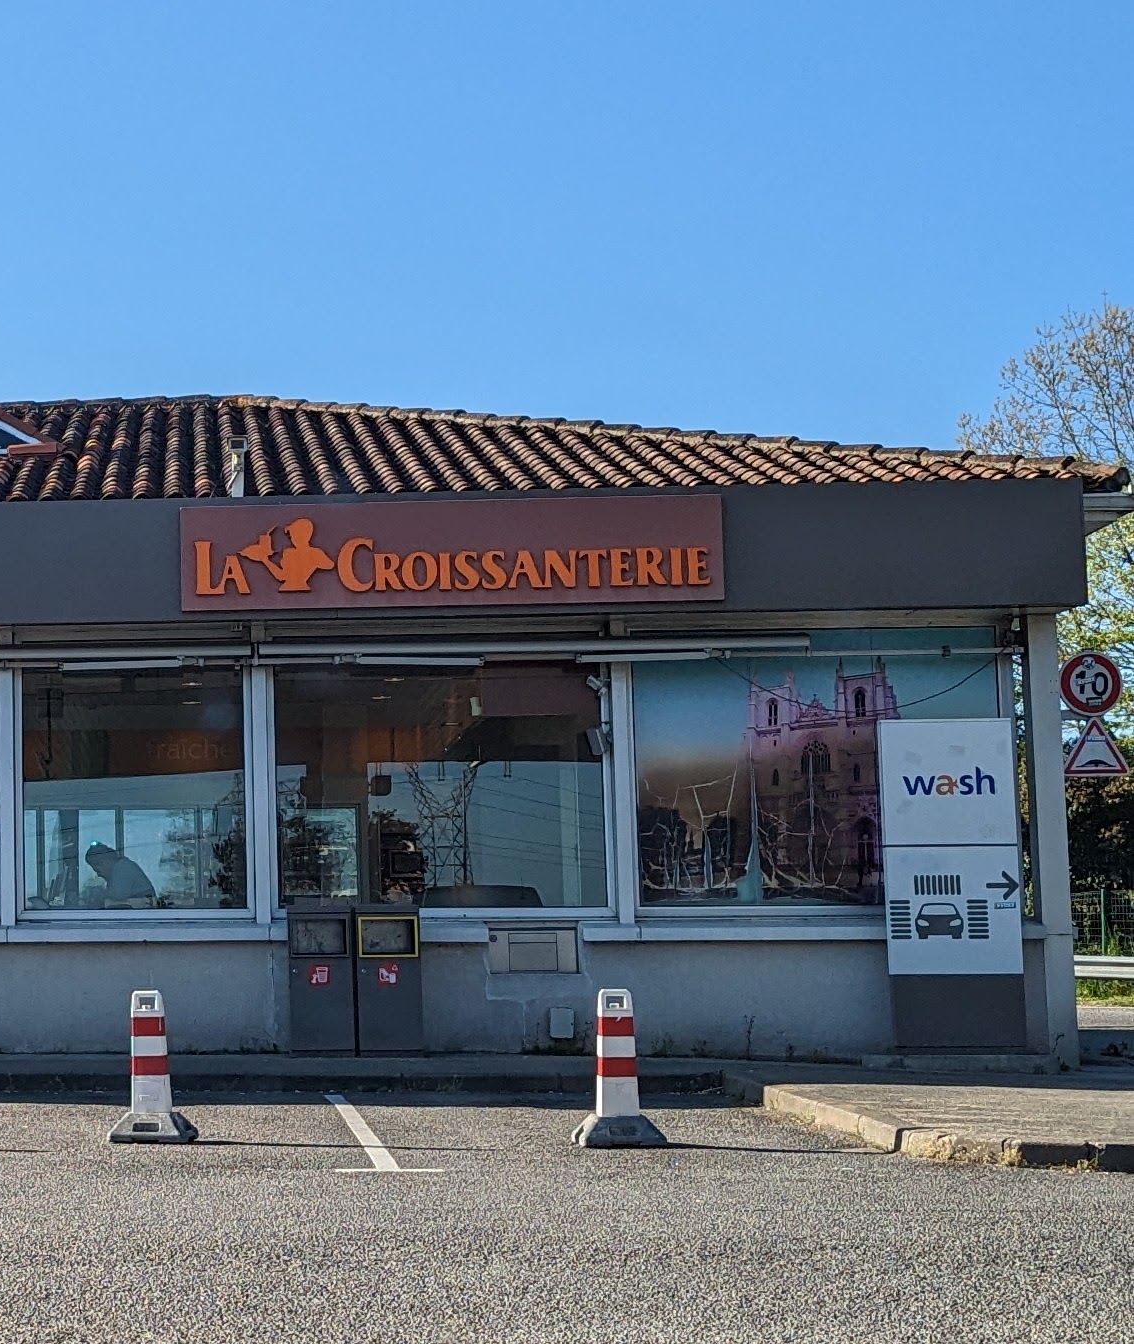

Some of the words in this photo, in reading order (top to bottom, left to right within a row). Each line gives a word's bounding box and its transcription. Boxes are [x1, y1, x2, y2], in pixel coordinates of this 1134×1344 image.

[194, 540, 251, 596] LA
[337, 537, 712, 593] CROISSANTERIE
[1075, 670, 1109, 697] 10
[902, 766, 996, 796] wash
